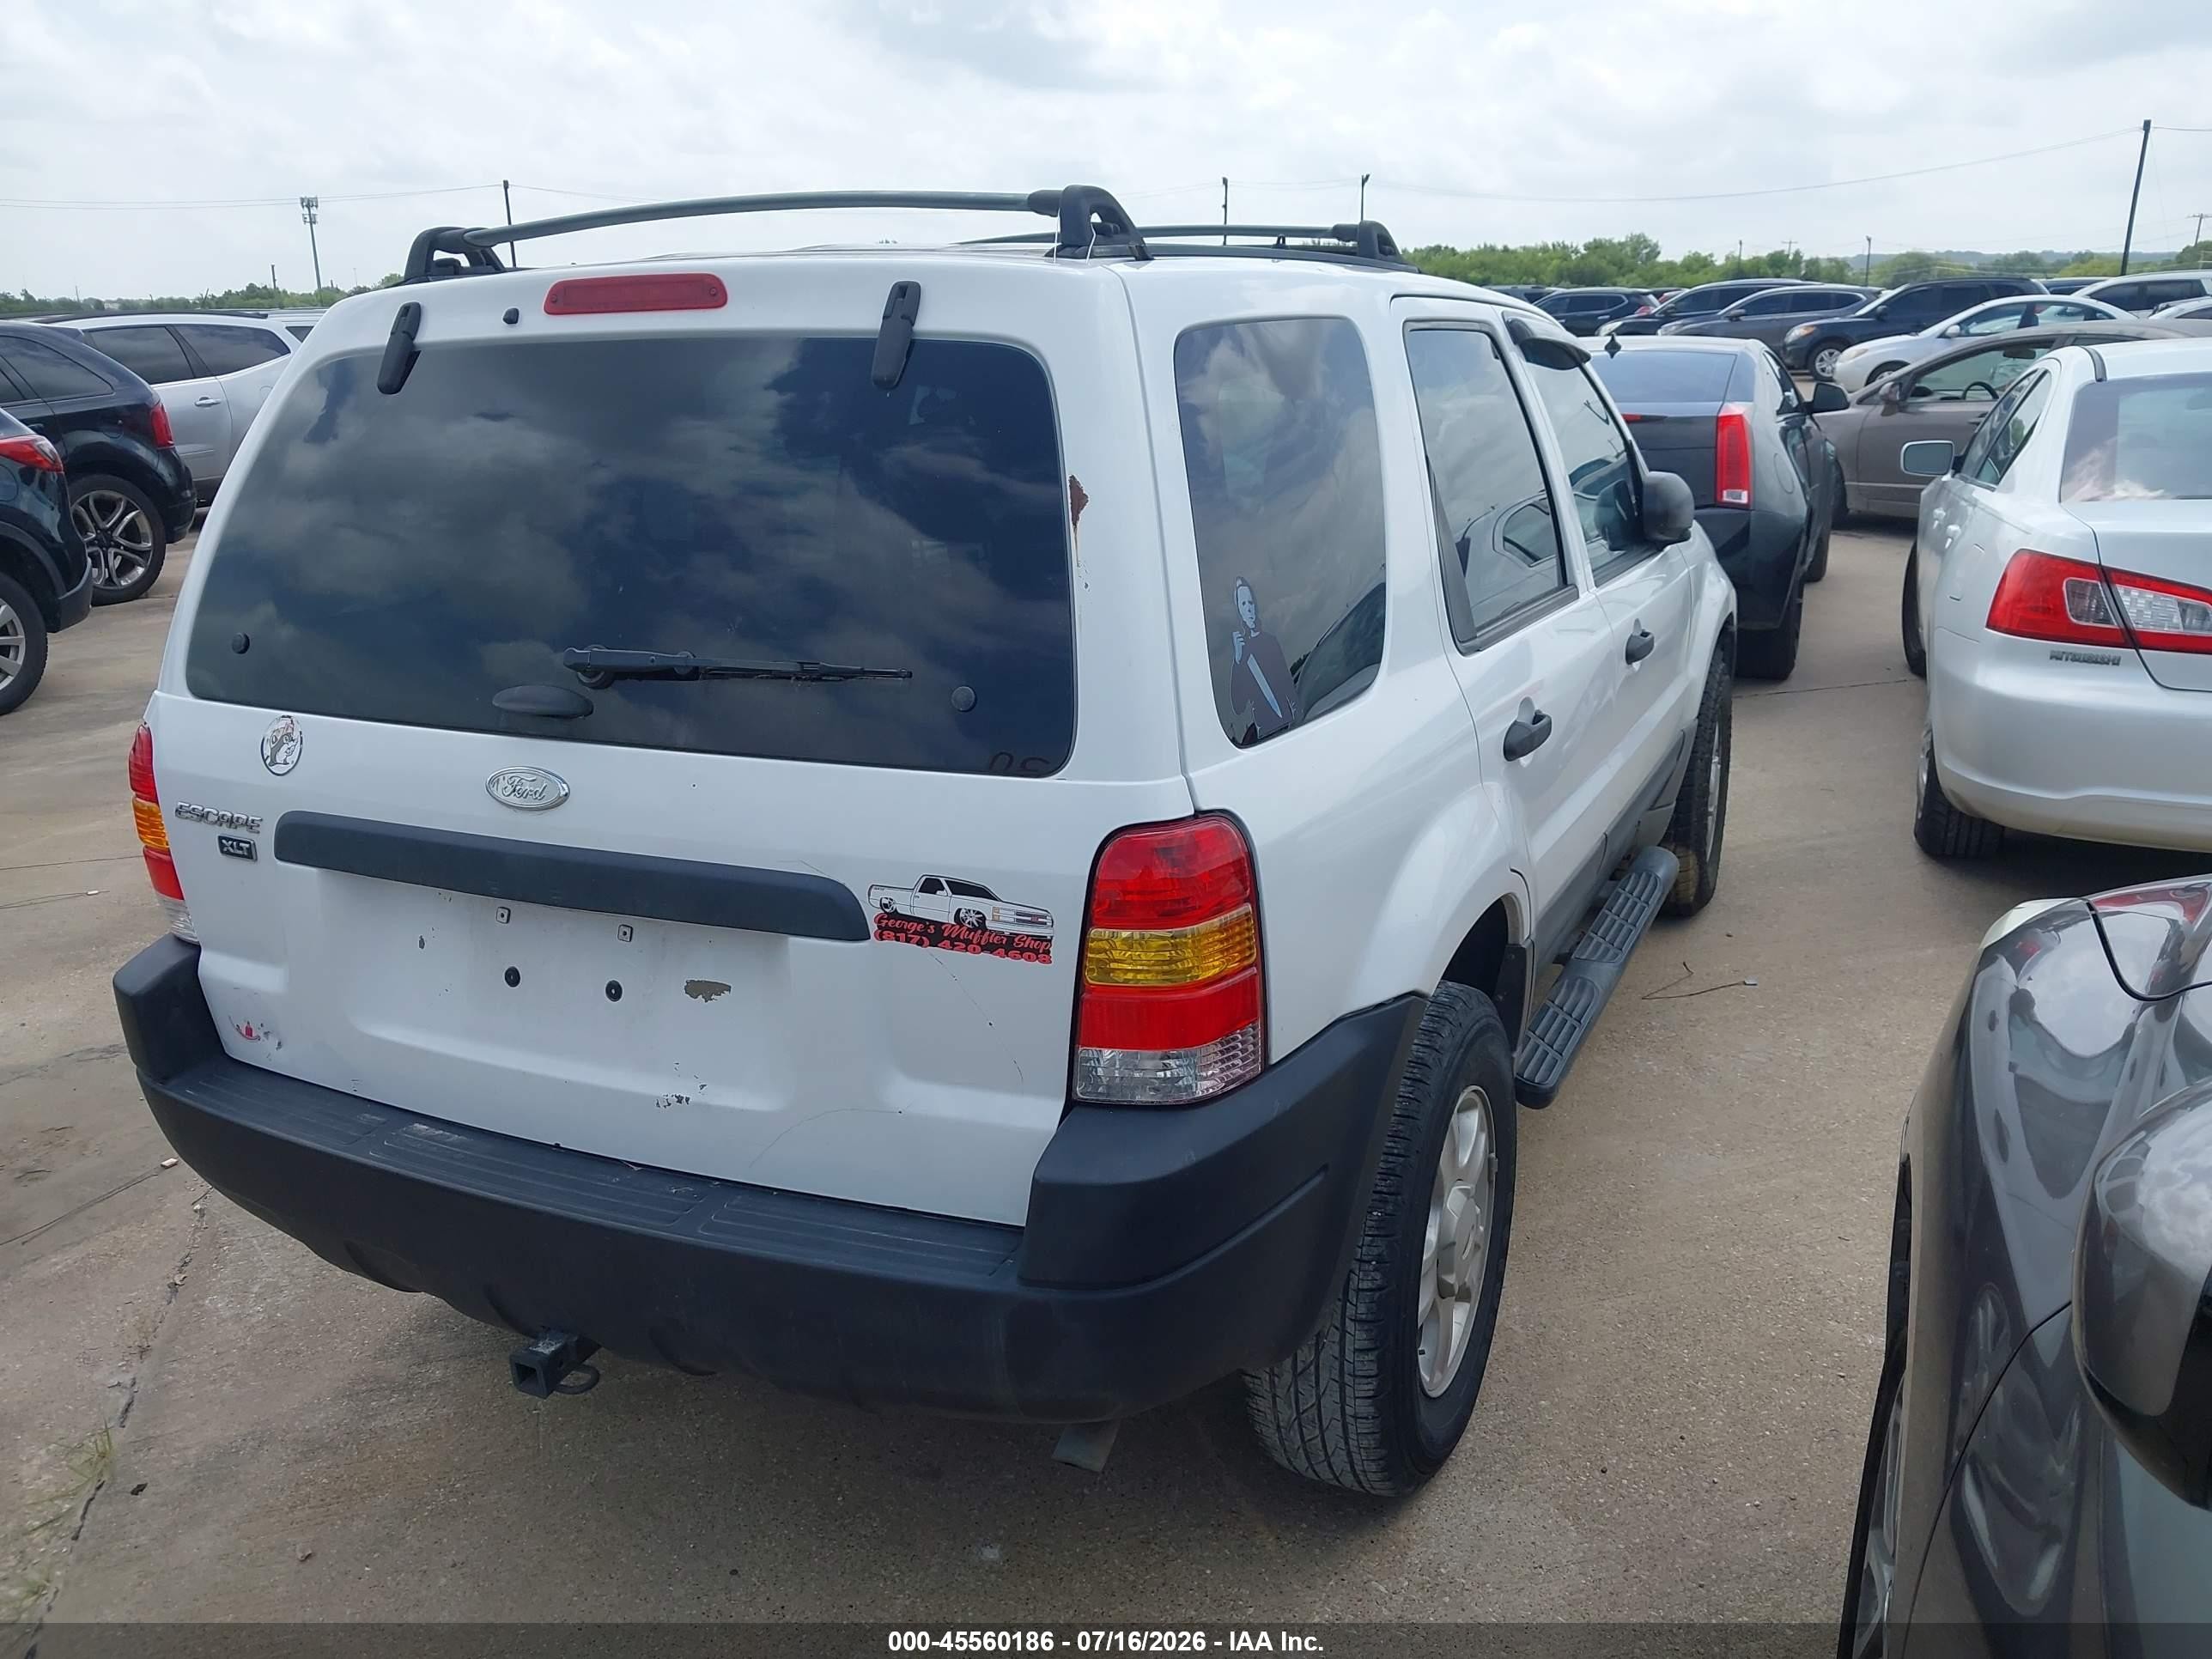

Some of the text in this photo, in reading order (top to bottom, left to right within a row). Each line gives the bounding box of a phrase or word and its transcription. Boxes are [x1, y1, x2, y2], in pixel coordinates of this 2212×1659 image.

[2050, 650, 2122, 666] MITSUBISHI
[501, 775, 547, 800] Ford
[175, 801, 263, 834] ESCAPE
[221, 838, 251, 856] XLT
[874, 913, 1051, 952] George's Muffler Shop
[874, 929, 930, 948] (817)
